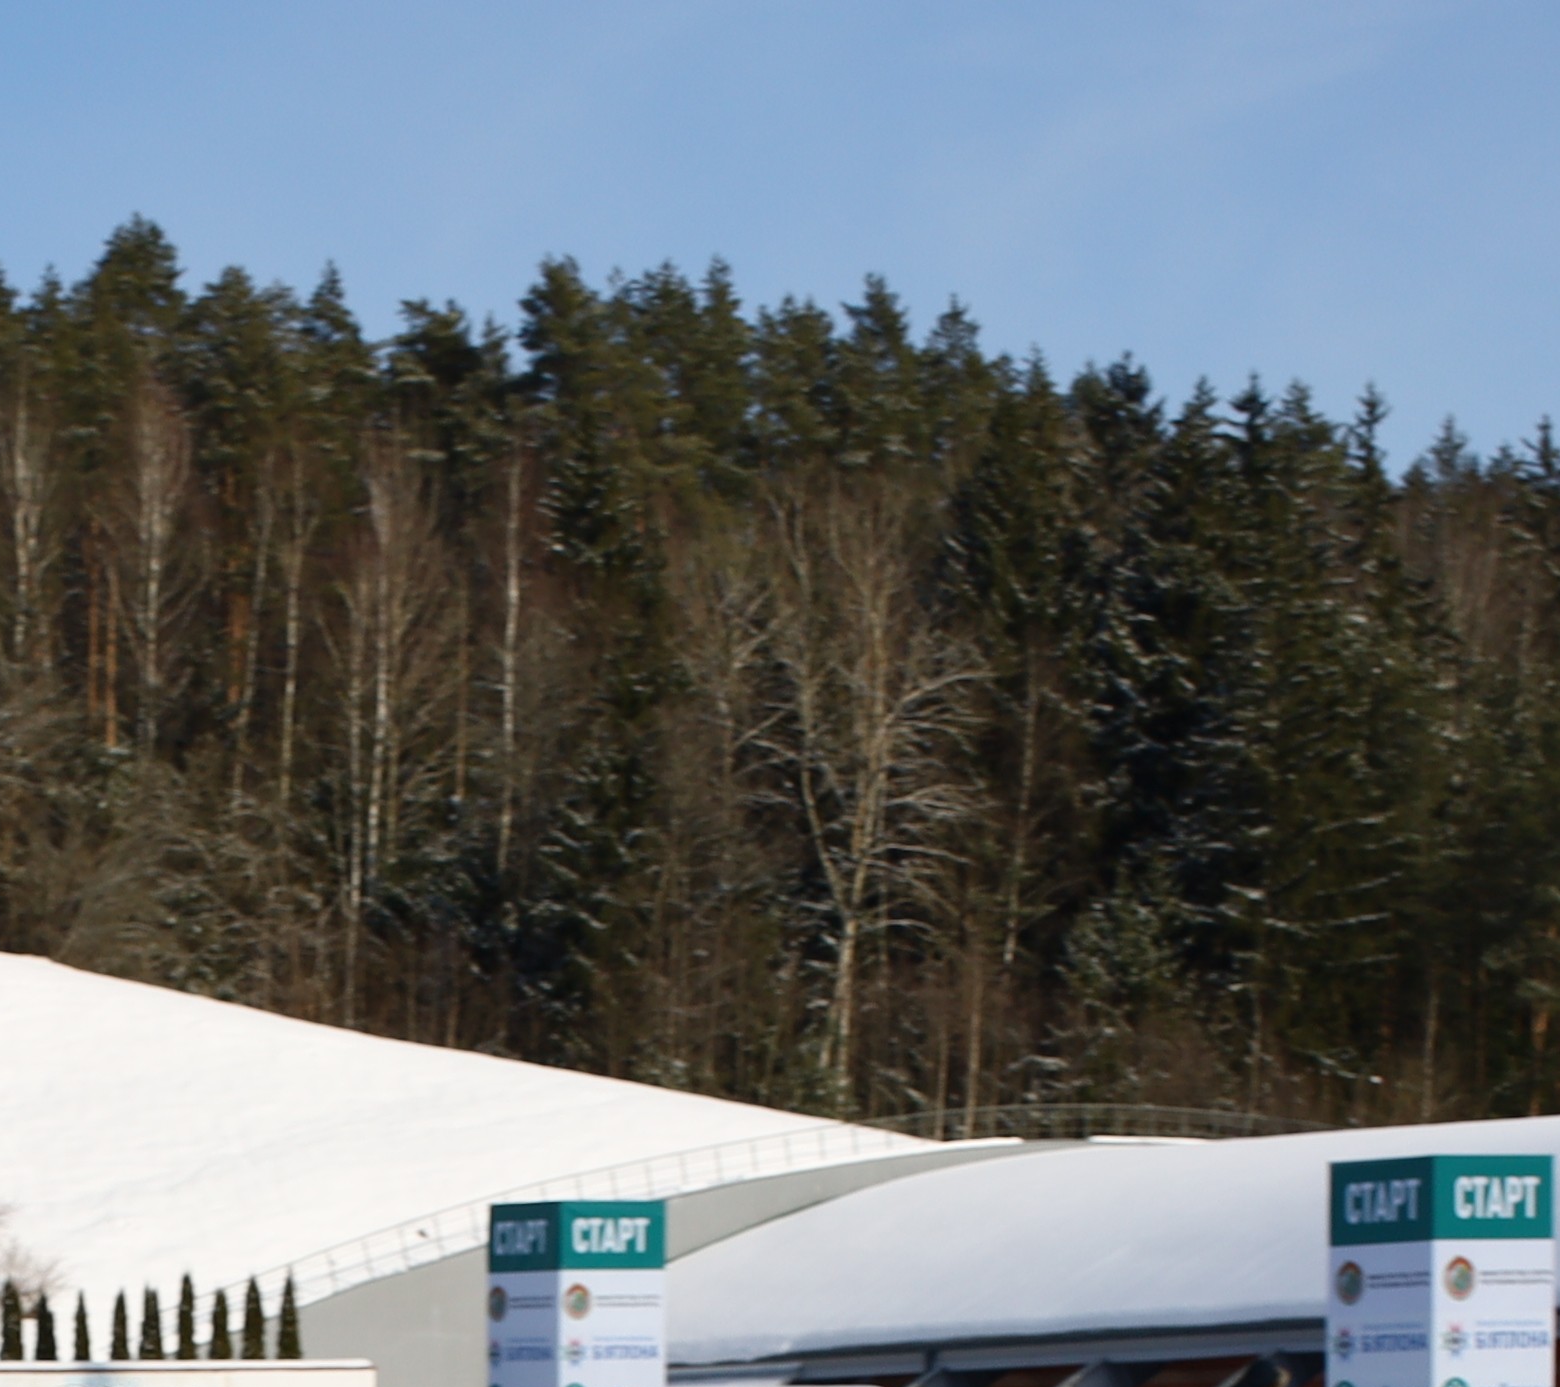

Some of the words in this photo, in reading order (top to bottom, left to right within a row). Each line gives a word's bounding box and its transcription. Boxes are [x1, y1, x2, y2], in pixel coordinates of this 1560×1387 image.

[1344, 1178, 1422, 1224] СТАРТ
[1453, 1175, 1541, 1219] СТАРТ
[493, 1219, 548, 1255] СТАРТ
[571, 1217, 651, 1253] СТАРТ
